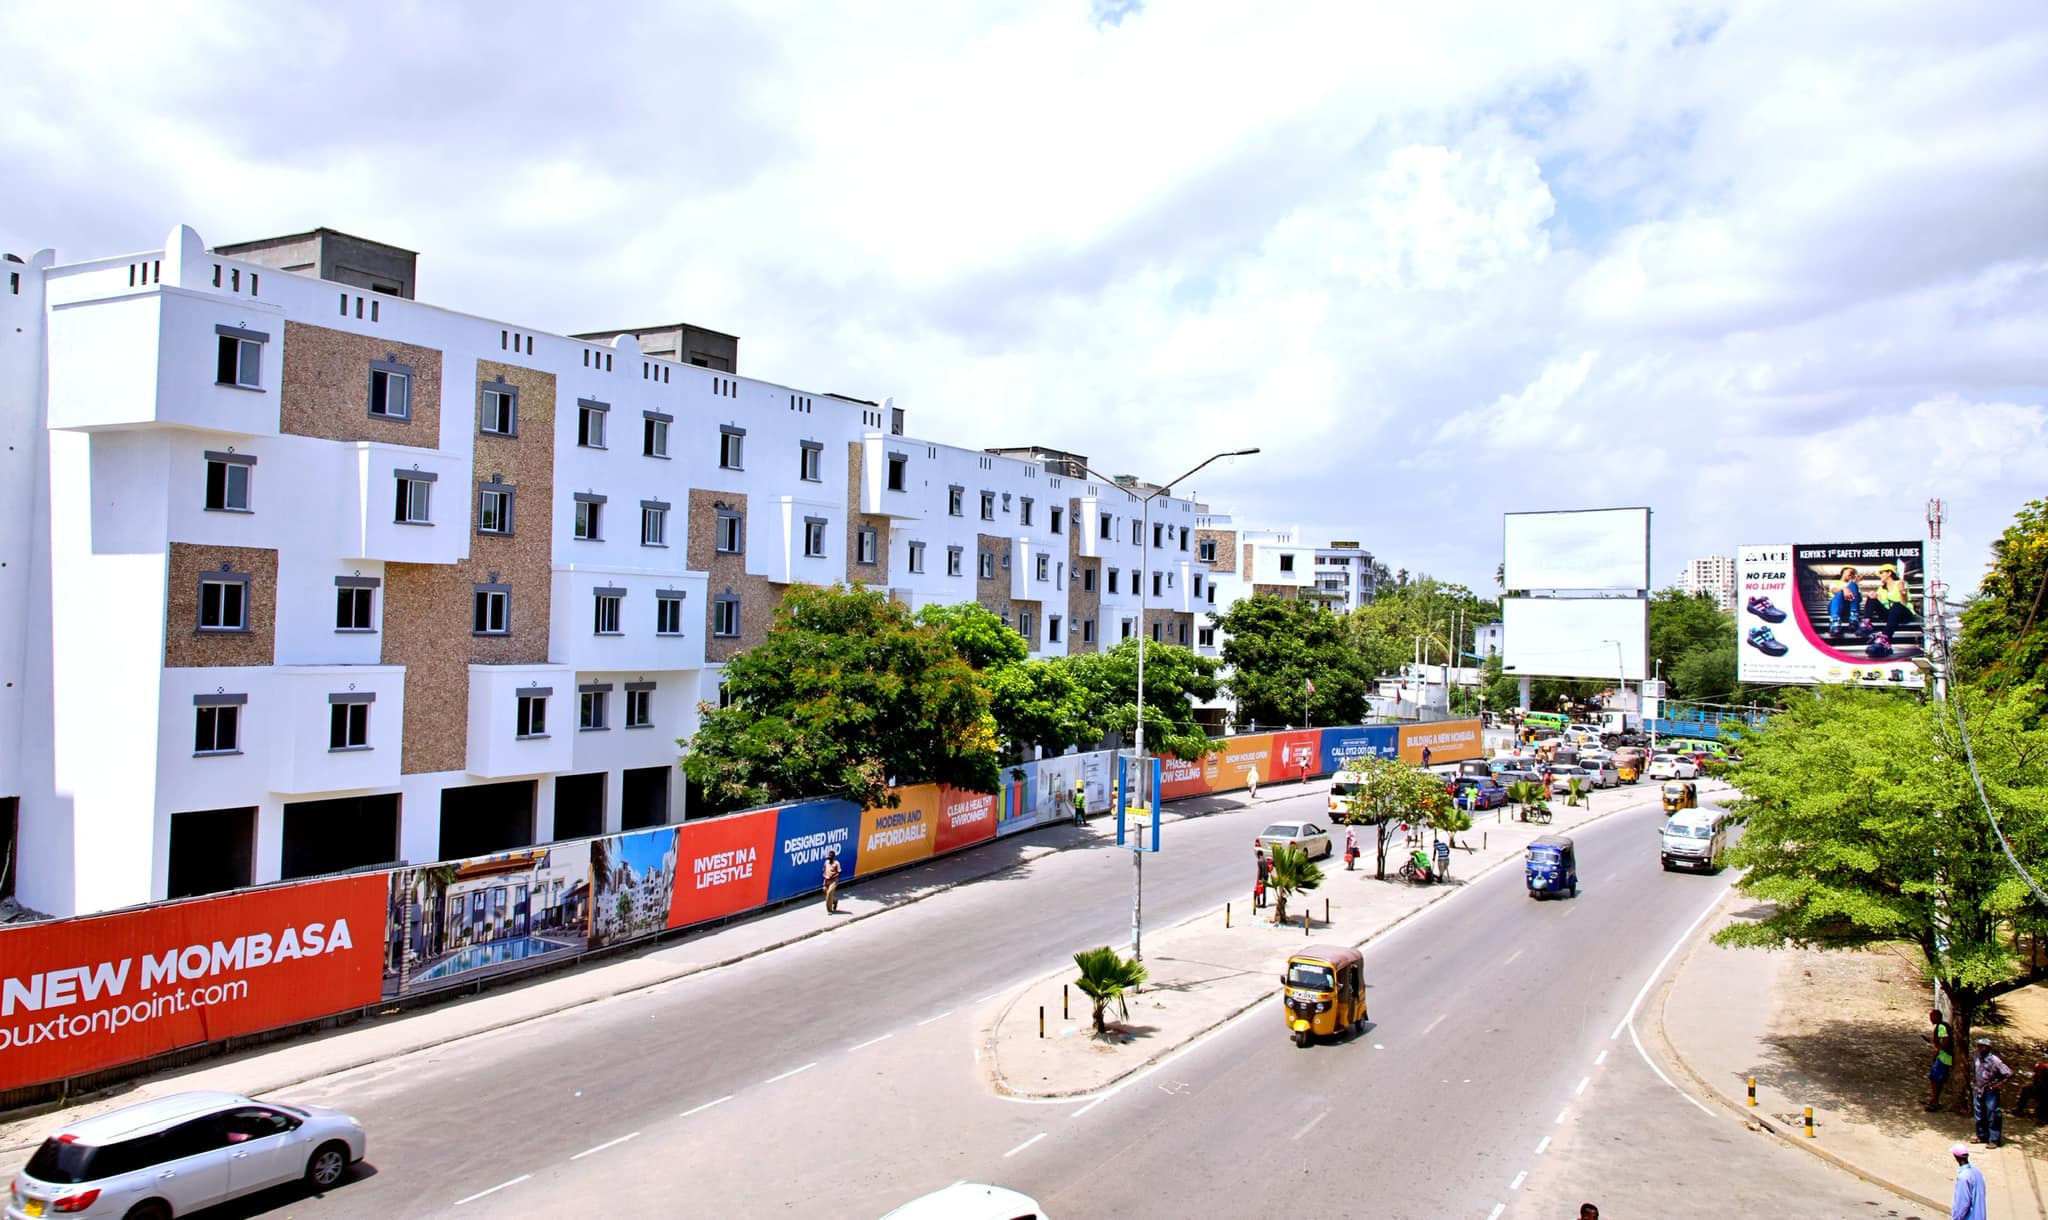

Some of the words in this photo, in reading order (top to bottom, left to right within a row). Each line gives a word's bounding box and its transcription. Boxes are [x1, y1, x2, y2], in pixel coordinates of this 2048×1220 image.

[1760, 552, 1789, 561] ACE
[1800, 550, 1826, 559] KENYA'S
[1837, 549, 1861, 559] SAFETY
[1862, 548, 1880, 558] SHOE
[1881, 548, 1895, 557] FOR
[1895, 547, 1920, 557] LADIES
[1746, 572, 1760, 580] NO
[1762, 572, 1786, 580] FEAR
[1745, 583, 1759, 591] NO
[1761, 582, 1786, 591] LIMIT
[1331, 747, 1346, 756] CALL
[1165, 758, 1187, 770] PHASE
[1174, 767, 1200, 781] SELLING
[947, 801, 965, 817] CLEAN
[876, 812, 906, 830] MODERN
[907, 809, 922, 823] AND
[784, 832, 826, 854] DESIGNED
[827, 826, 848, 844] WITH
[866, 822, 927, 852] AFFORDABLE
[694, 851, 735, 874] INVEST
[736, 848, 747, 864] IN
[748, 846, 757, 862] A
[791, 849, 810, 866] YOU
[810, 847, 820, 862] IN
[696, 862, 753, 889] LIFESTYLE
[1, 958, 132, 1016] NEW
[140, 918, 353, 991] MOMBASA
